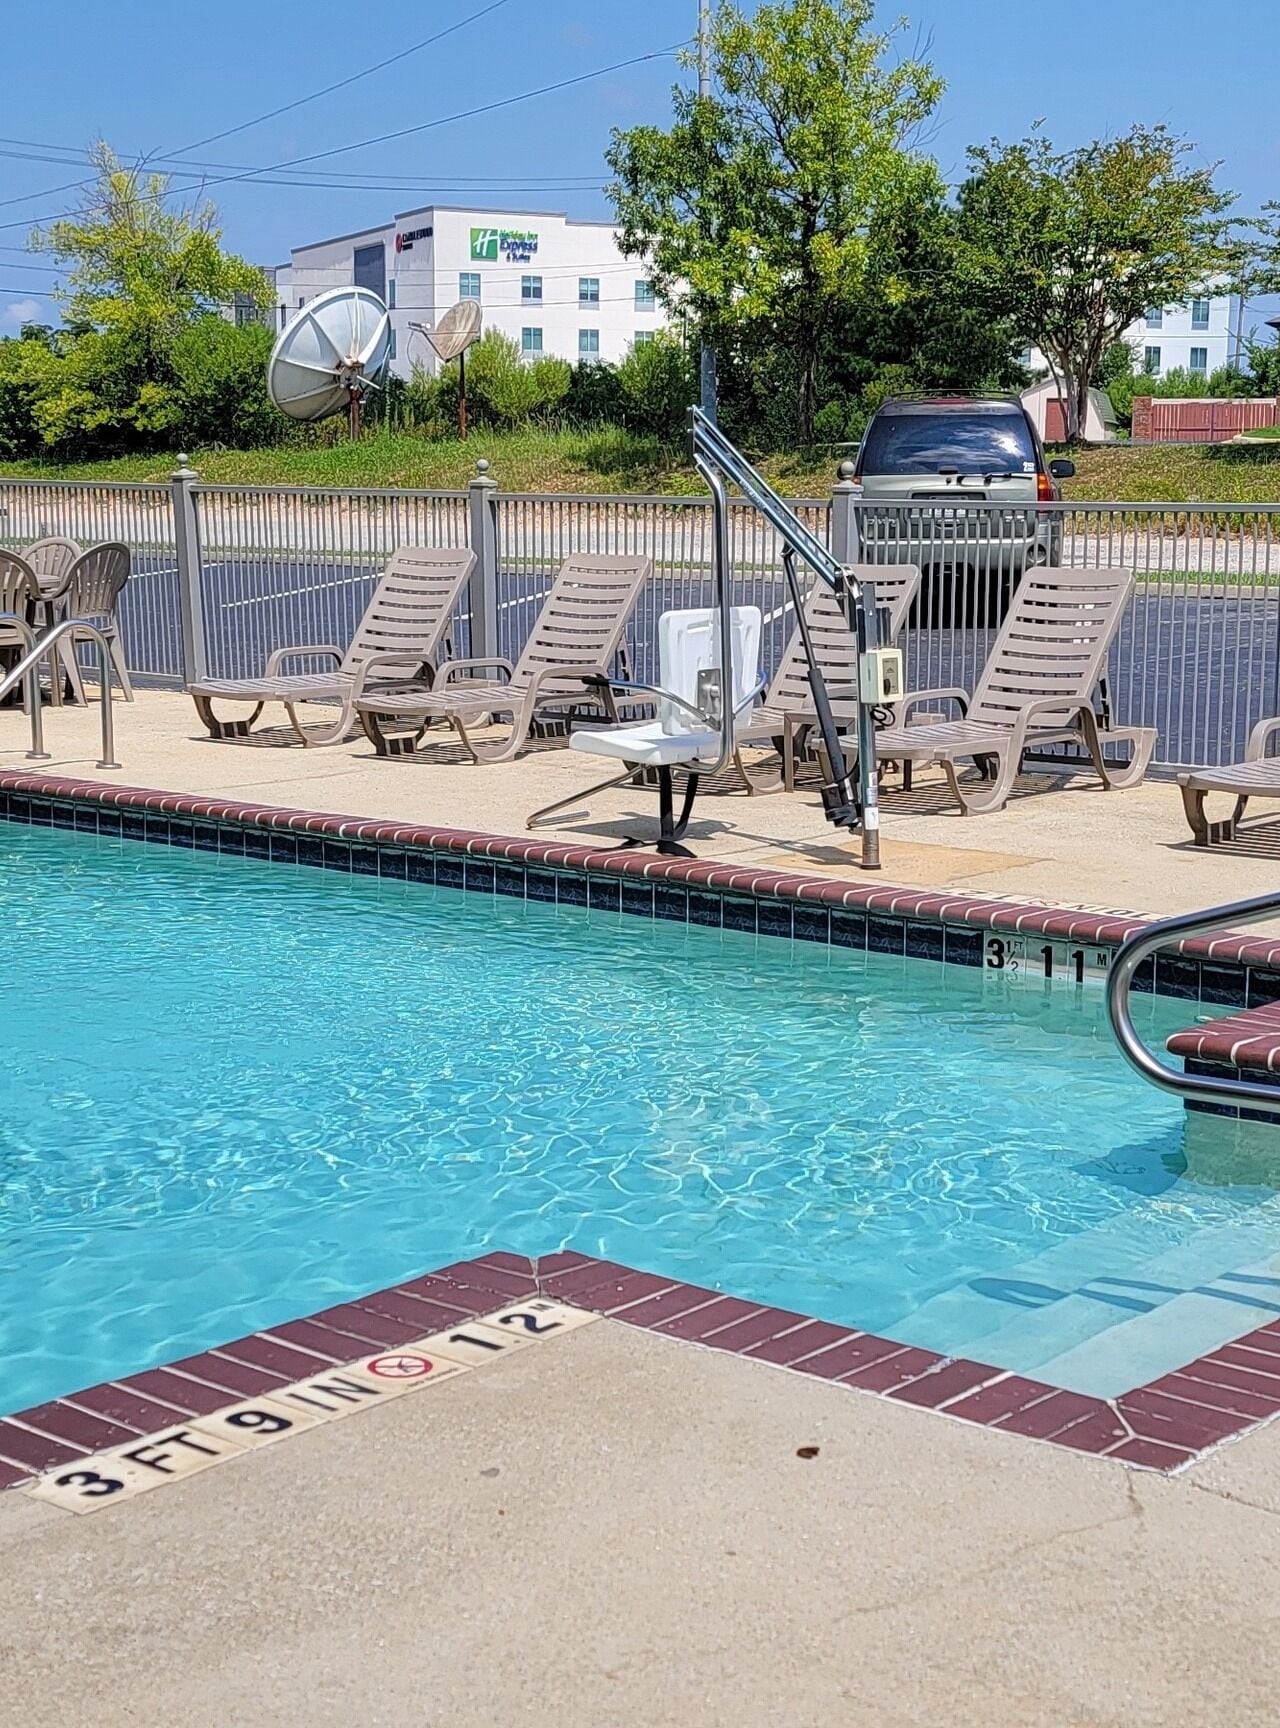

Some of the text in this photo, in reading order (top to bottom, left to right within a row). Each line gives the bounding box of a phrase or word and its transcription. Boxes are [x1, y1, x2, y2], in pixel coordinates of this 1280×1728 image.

[499, 239, 537, 253] Express
[55, 1471, 124, 1497] 3
[123, 1431, 221, 1474] FT
[225, 1410, 293, 1434] 9
[287, 1376, 381, 1412] IN
